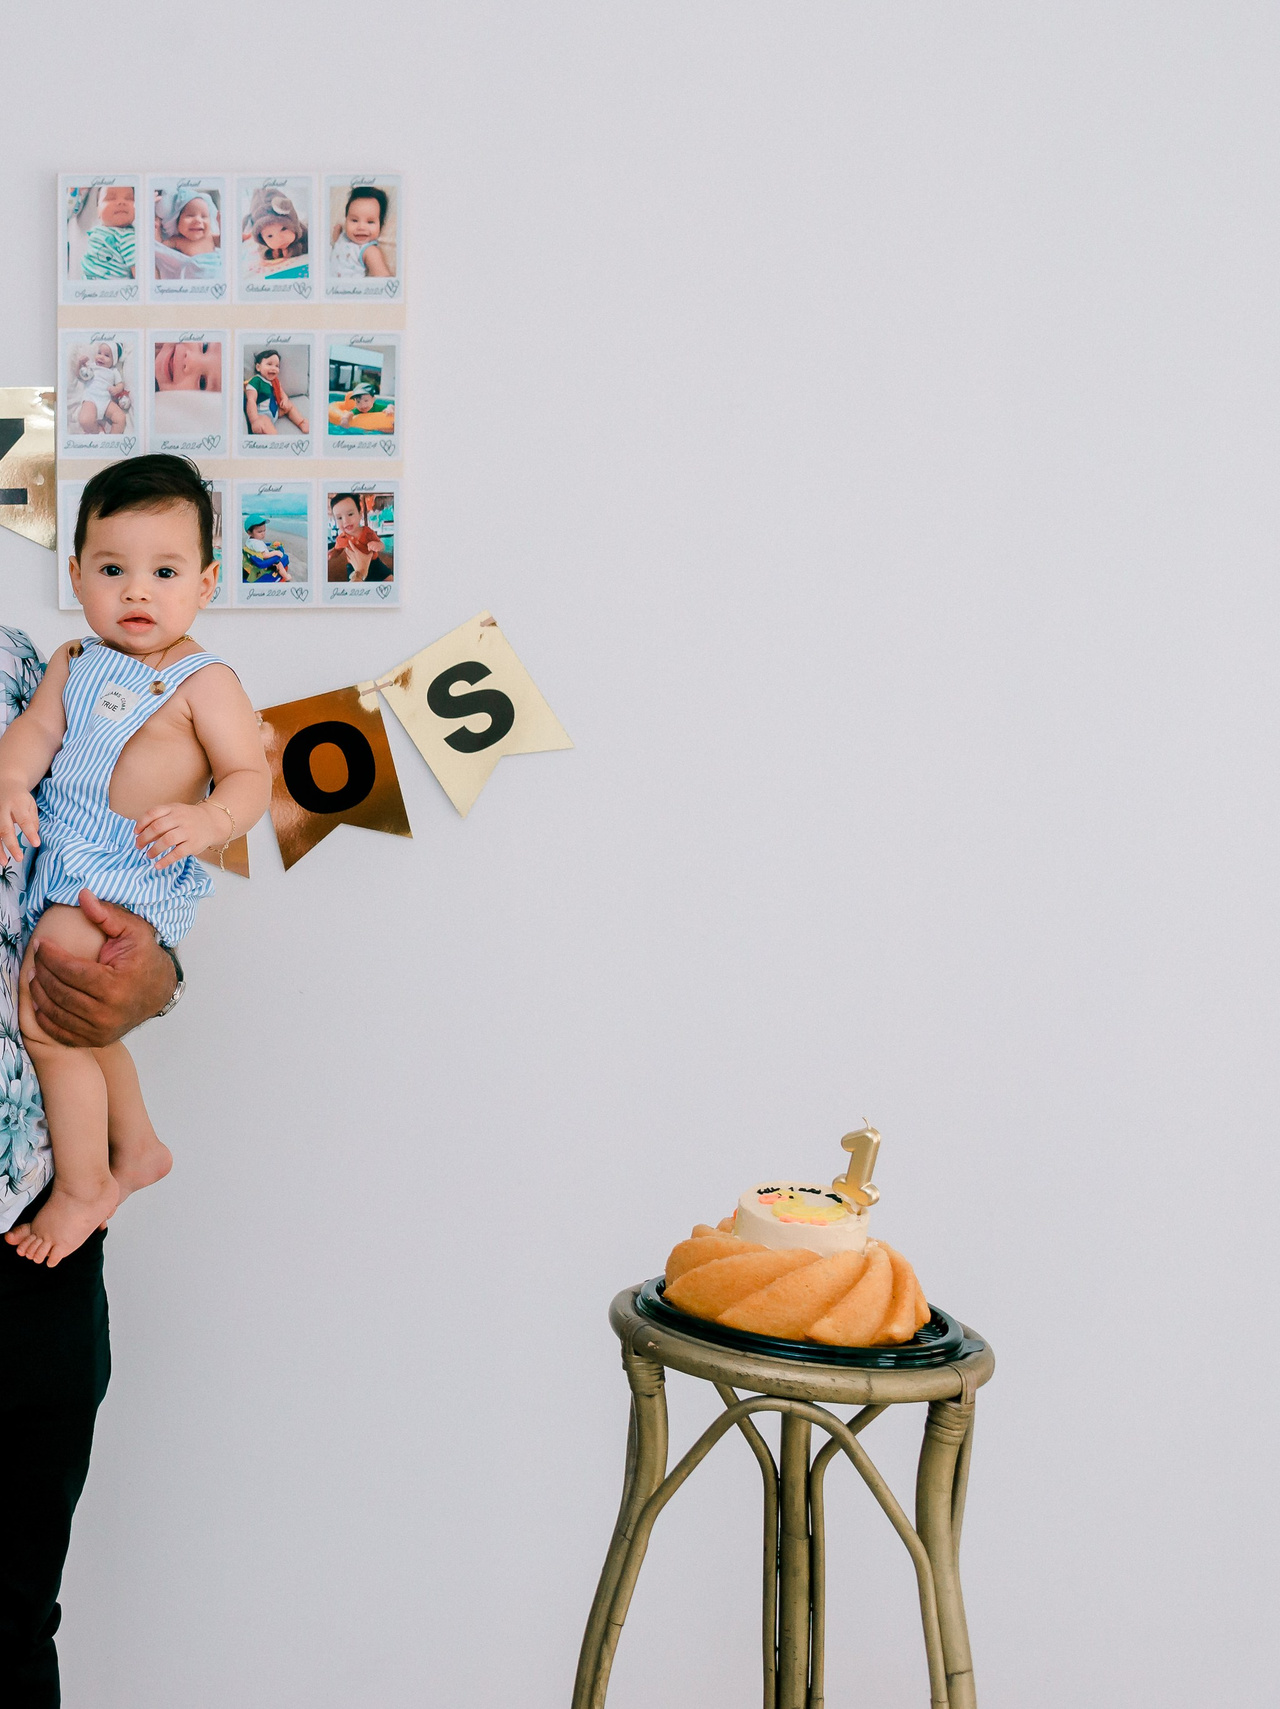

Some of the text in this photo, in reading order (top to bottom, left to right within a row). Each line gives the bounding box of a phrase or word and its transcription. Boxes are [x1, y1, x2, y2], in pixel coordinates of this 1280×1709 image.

[90, 332, 116, 344] Gabriel
[179, 332, 205, 343] Gabriel
[266, 334, 292, 346] Gabriel
[349, 334, 375, 346] Gabriel
[180, 441, 202, 450] 2024
[269, 441, 290, 450] 2024
[357, 441, 378, 449] 2024
[258, 483, 283, 496] Gabriel
[350, 482, 377, 493] Gabriel
[246, 588, 286, 600] Junio 2024
[329, 587, 370, 600] Julio 2024
[101, 700, 119, 712] TRUE
